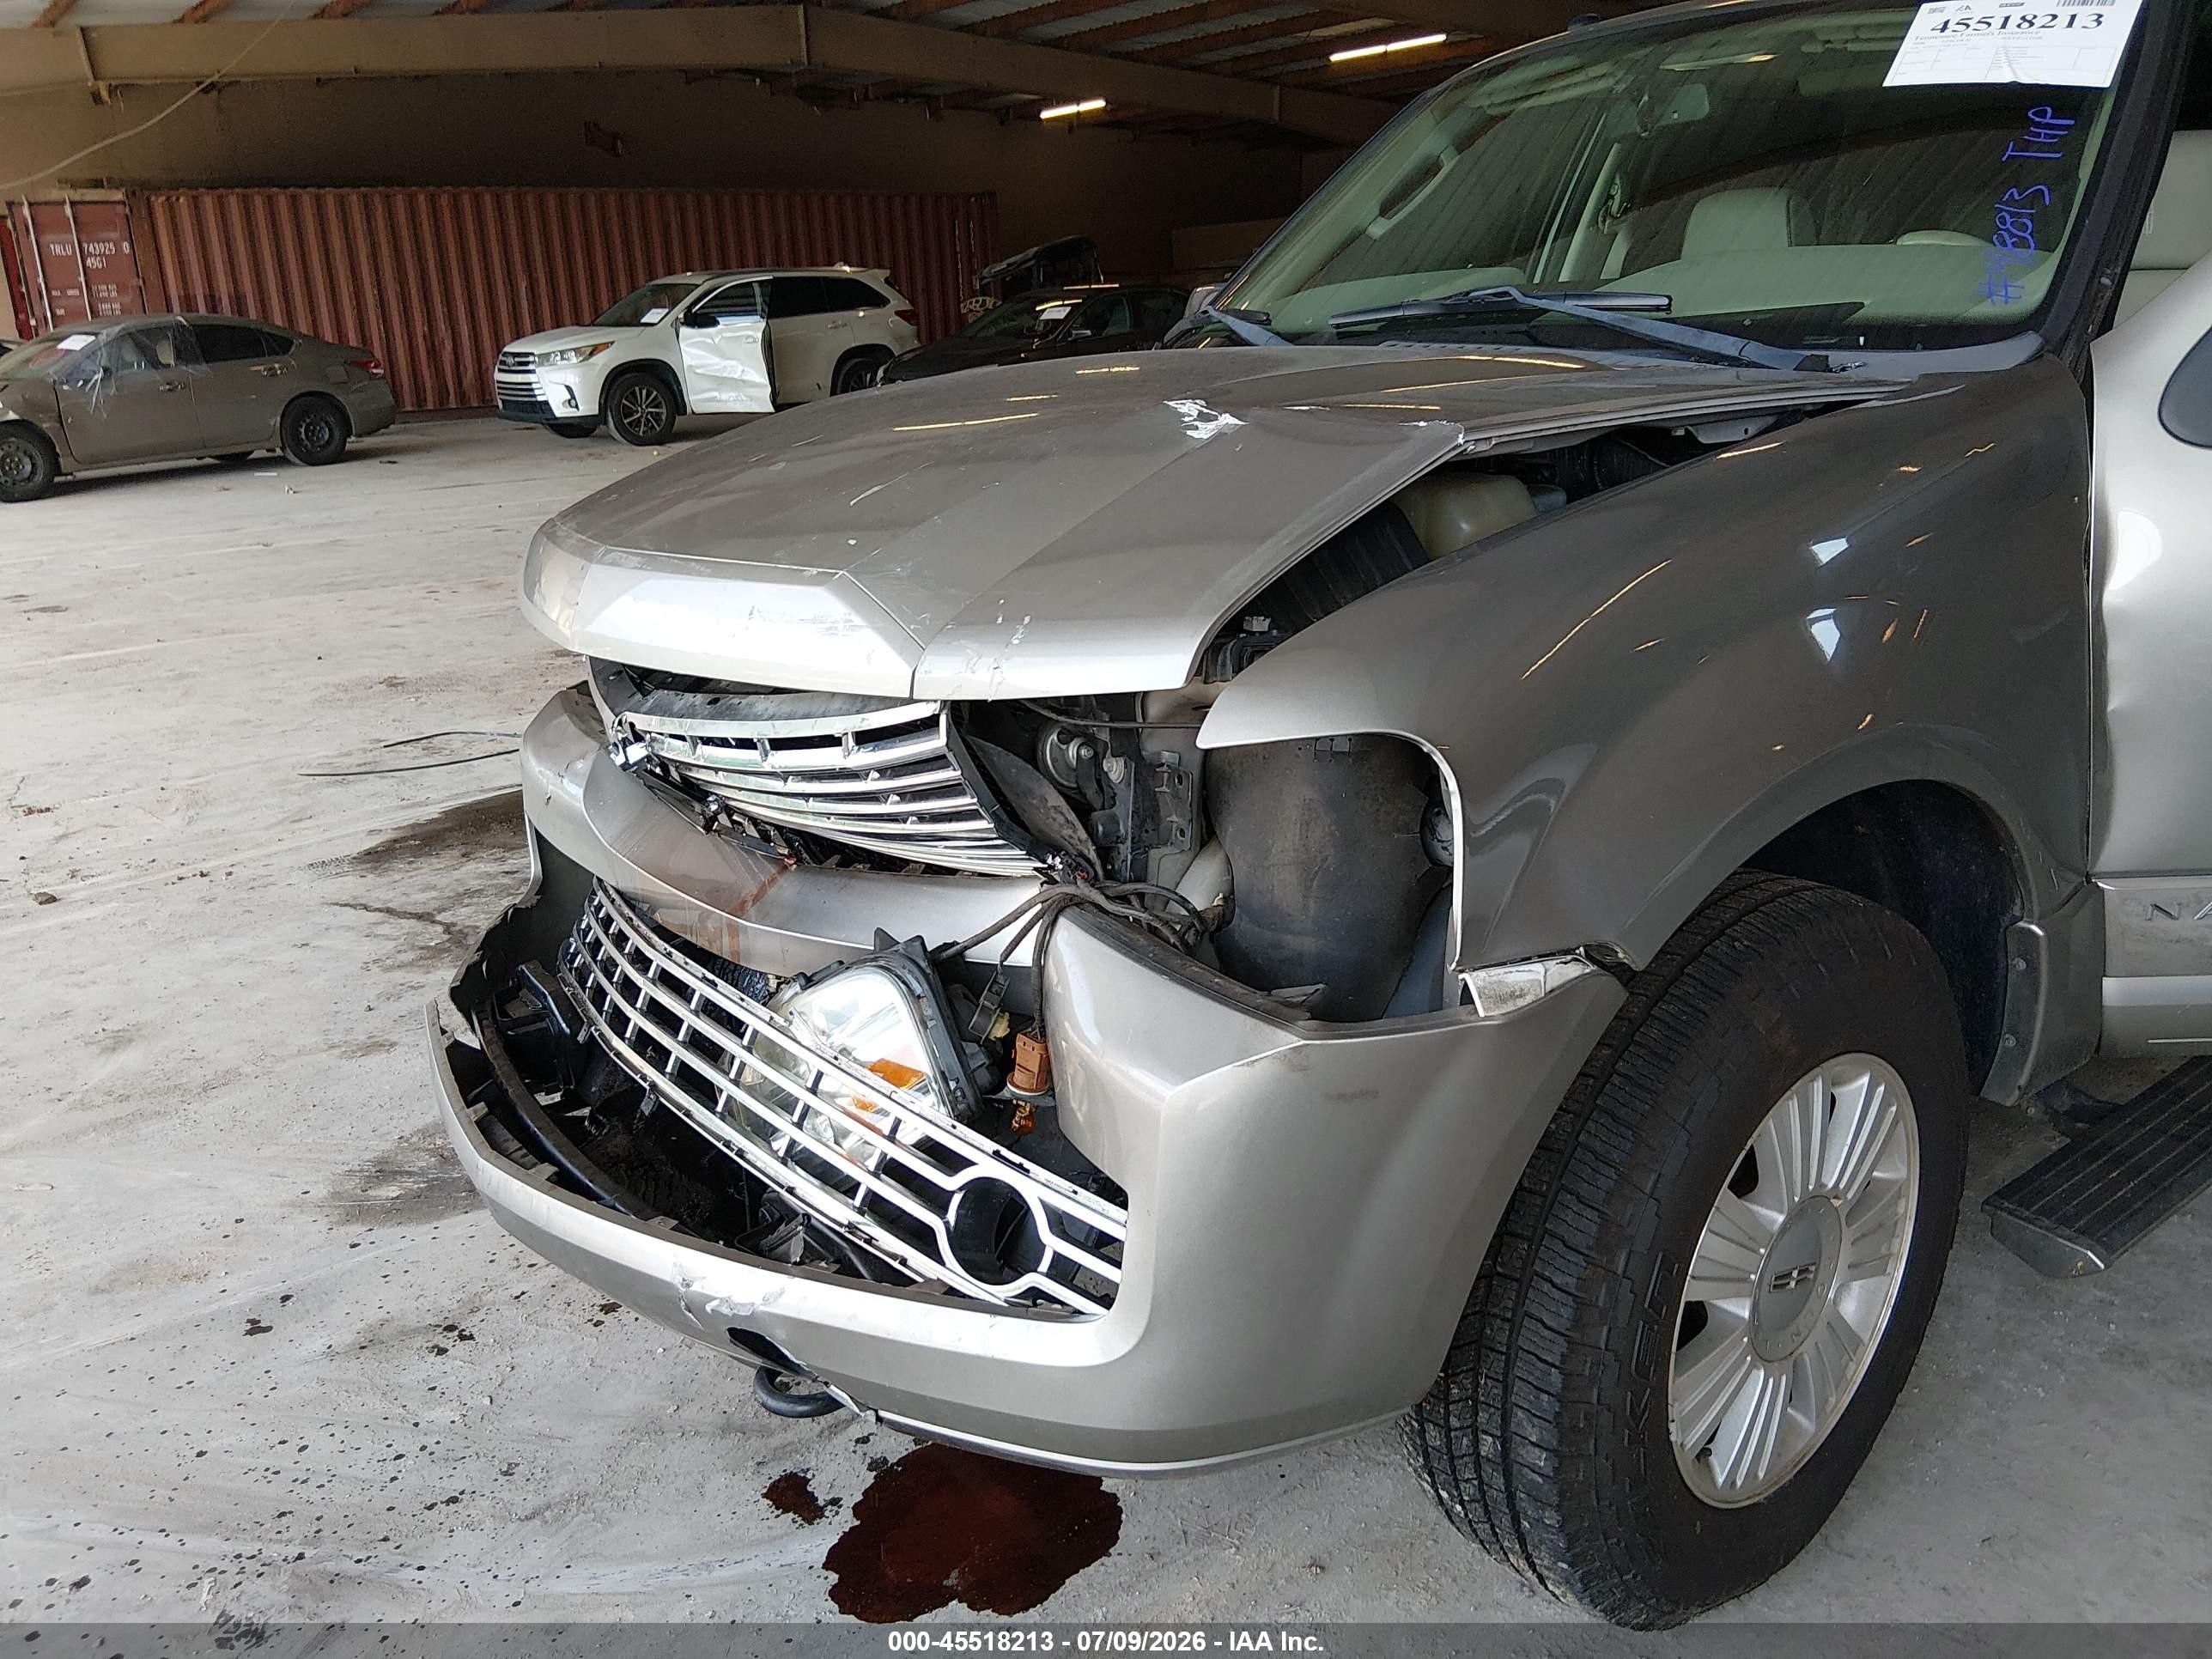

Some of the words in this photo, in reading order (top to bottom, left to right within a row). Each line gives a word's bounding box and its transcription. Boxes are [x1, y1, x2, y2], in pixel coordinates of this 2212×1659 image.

[1930, 13, 2105, 33] 45518213
[2002, 106, 2075, 161] THP
[49, 243, 73, 257] TRLU
[82, 241, 116, 255] 743925
